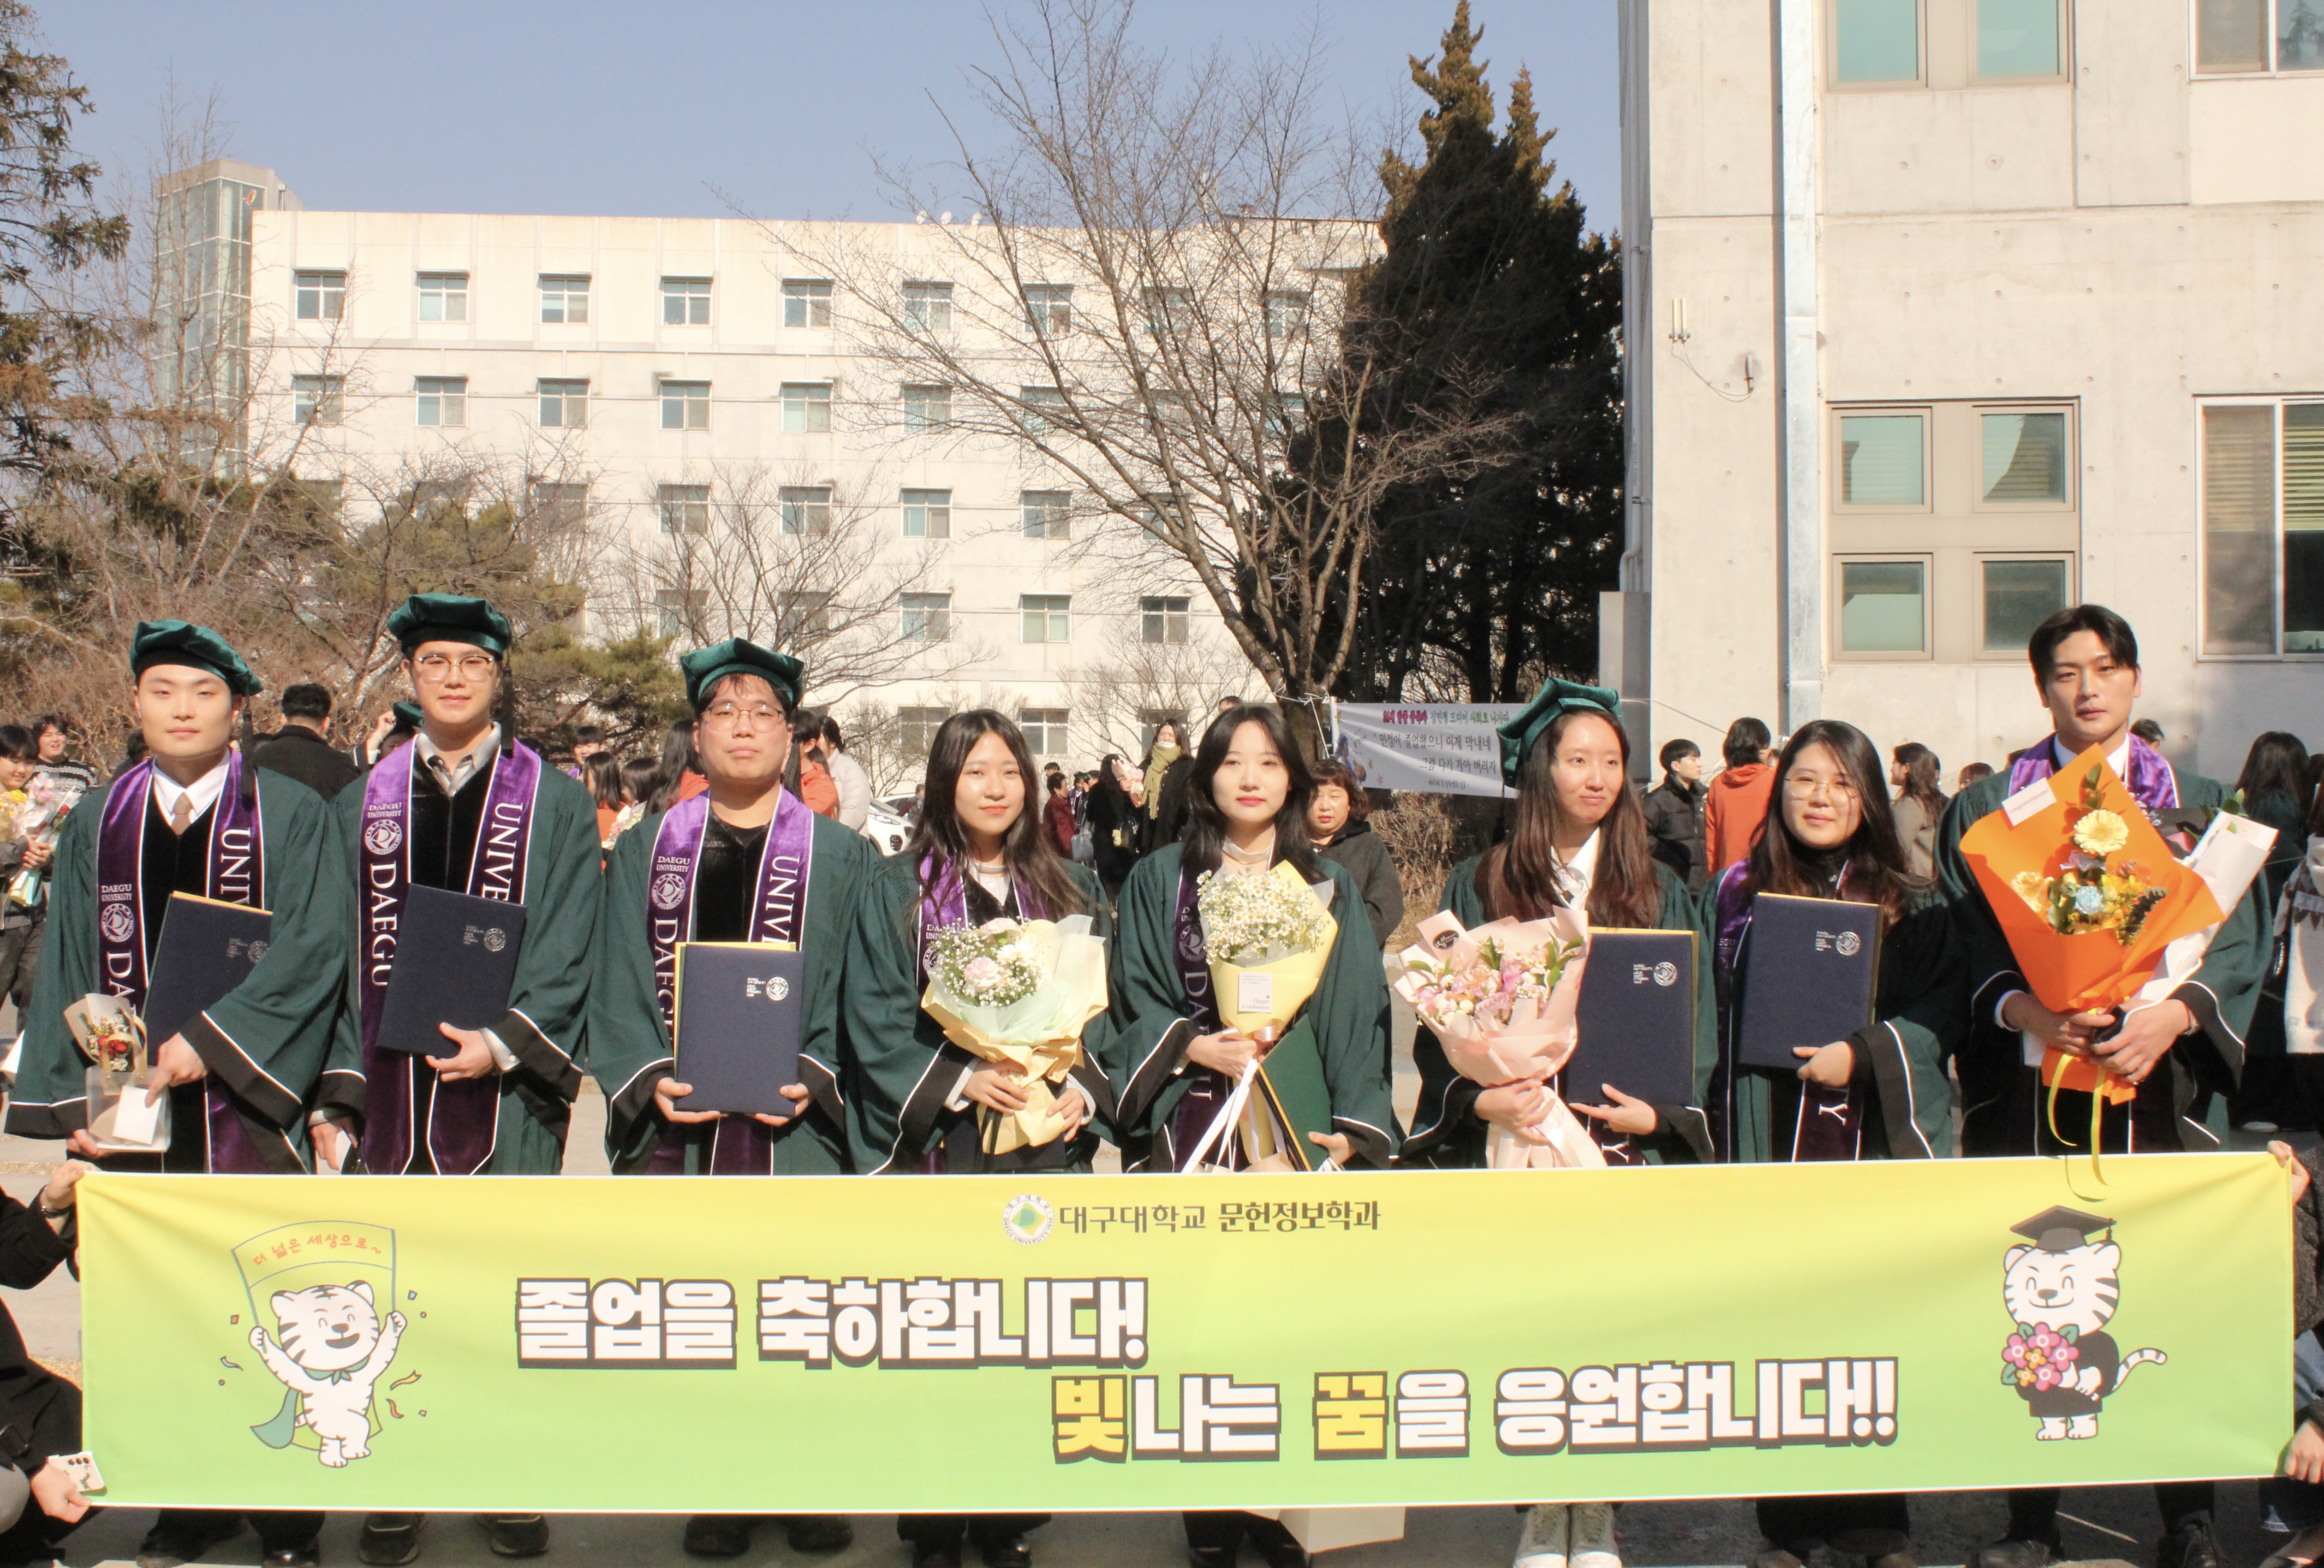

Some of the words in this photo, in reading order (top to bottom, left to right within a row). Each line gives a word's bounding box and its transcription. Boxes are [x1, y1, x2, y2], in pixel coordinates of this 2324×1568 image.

[1404, 733, 1442, 749] 졸업했으니
[1465, 735, 1490, 751] 막내네
[1439, 757, 1453, 772] 다시
[369, 802, 402, 811] DAEGU
[368, 810, 402, 819] UNIVERSITY
[657, 856, 691, 865] DAEGU
[656, 864, 690, 873] UNIVERSITY
[101, 884, 132, 893] DAEGU
[101, 893, 132, 902] UNIVERSITY
[370, 861, 398, 986] DAEGU
[1059, 1203, 1206, 1233] 대구대학교
[1218, 1200, 1381, 1232] 문헌정보학과
[1003, 1218, 1014, 1237] DAEGU
[1014, 1231, 1049, 1245] UNIVERSITY
[253, 1253, 267, 1265] 더
[515, 1278, 738, 1371] 졸업을
[757, 1276, 1149, 1371] 축하합니다!
[1051, 1372, 1282, 1464] 빛나는
[1313, 1369, 1471, 1461] 꿈을
[1493, 1357, 1899, 1456] 응원합니다!!
